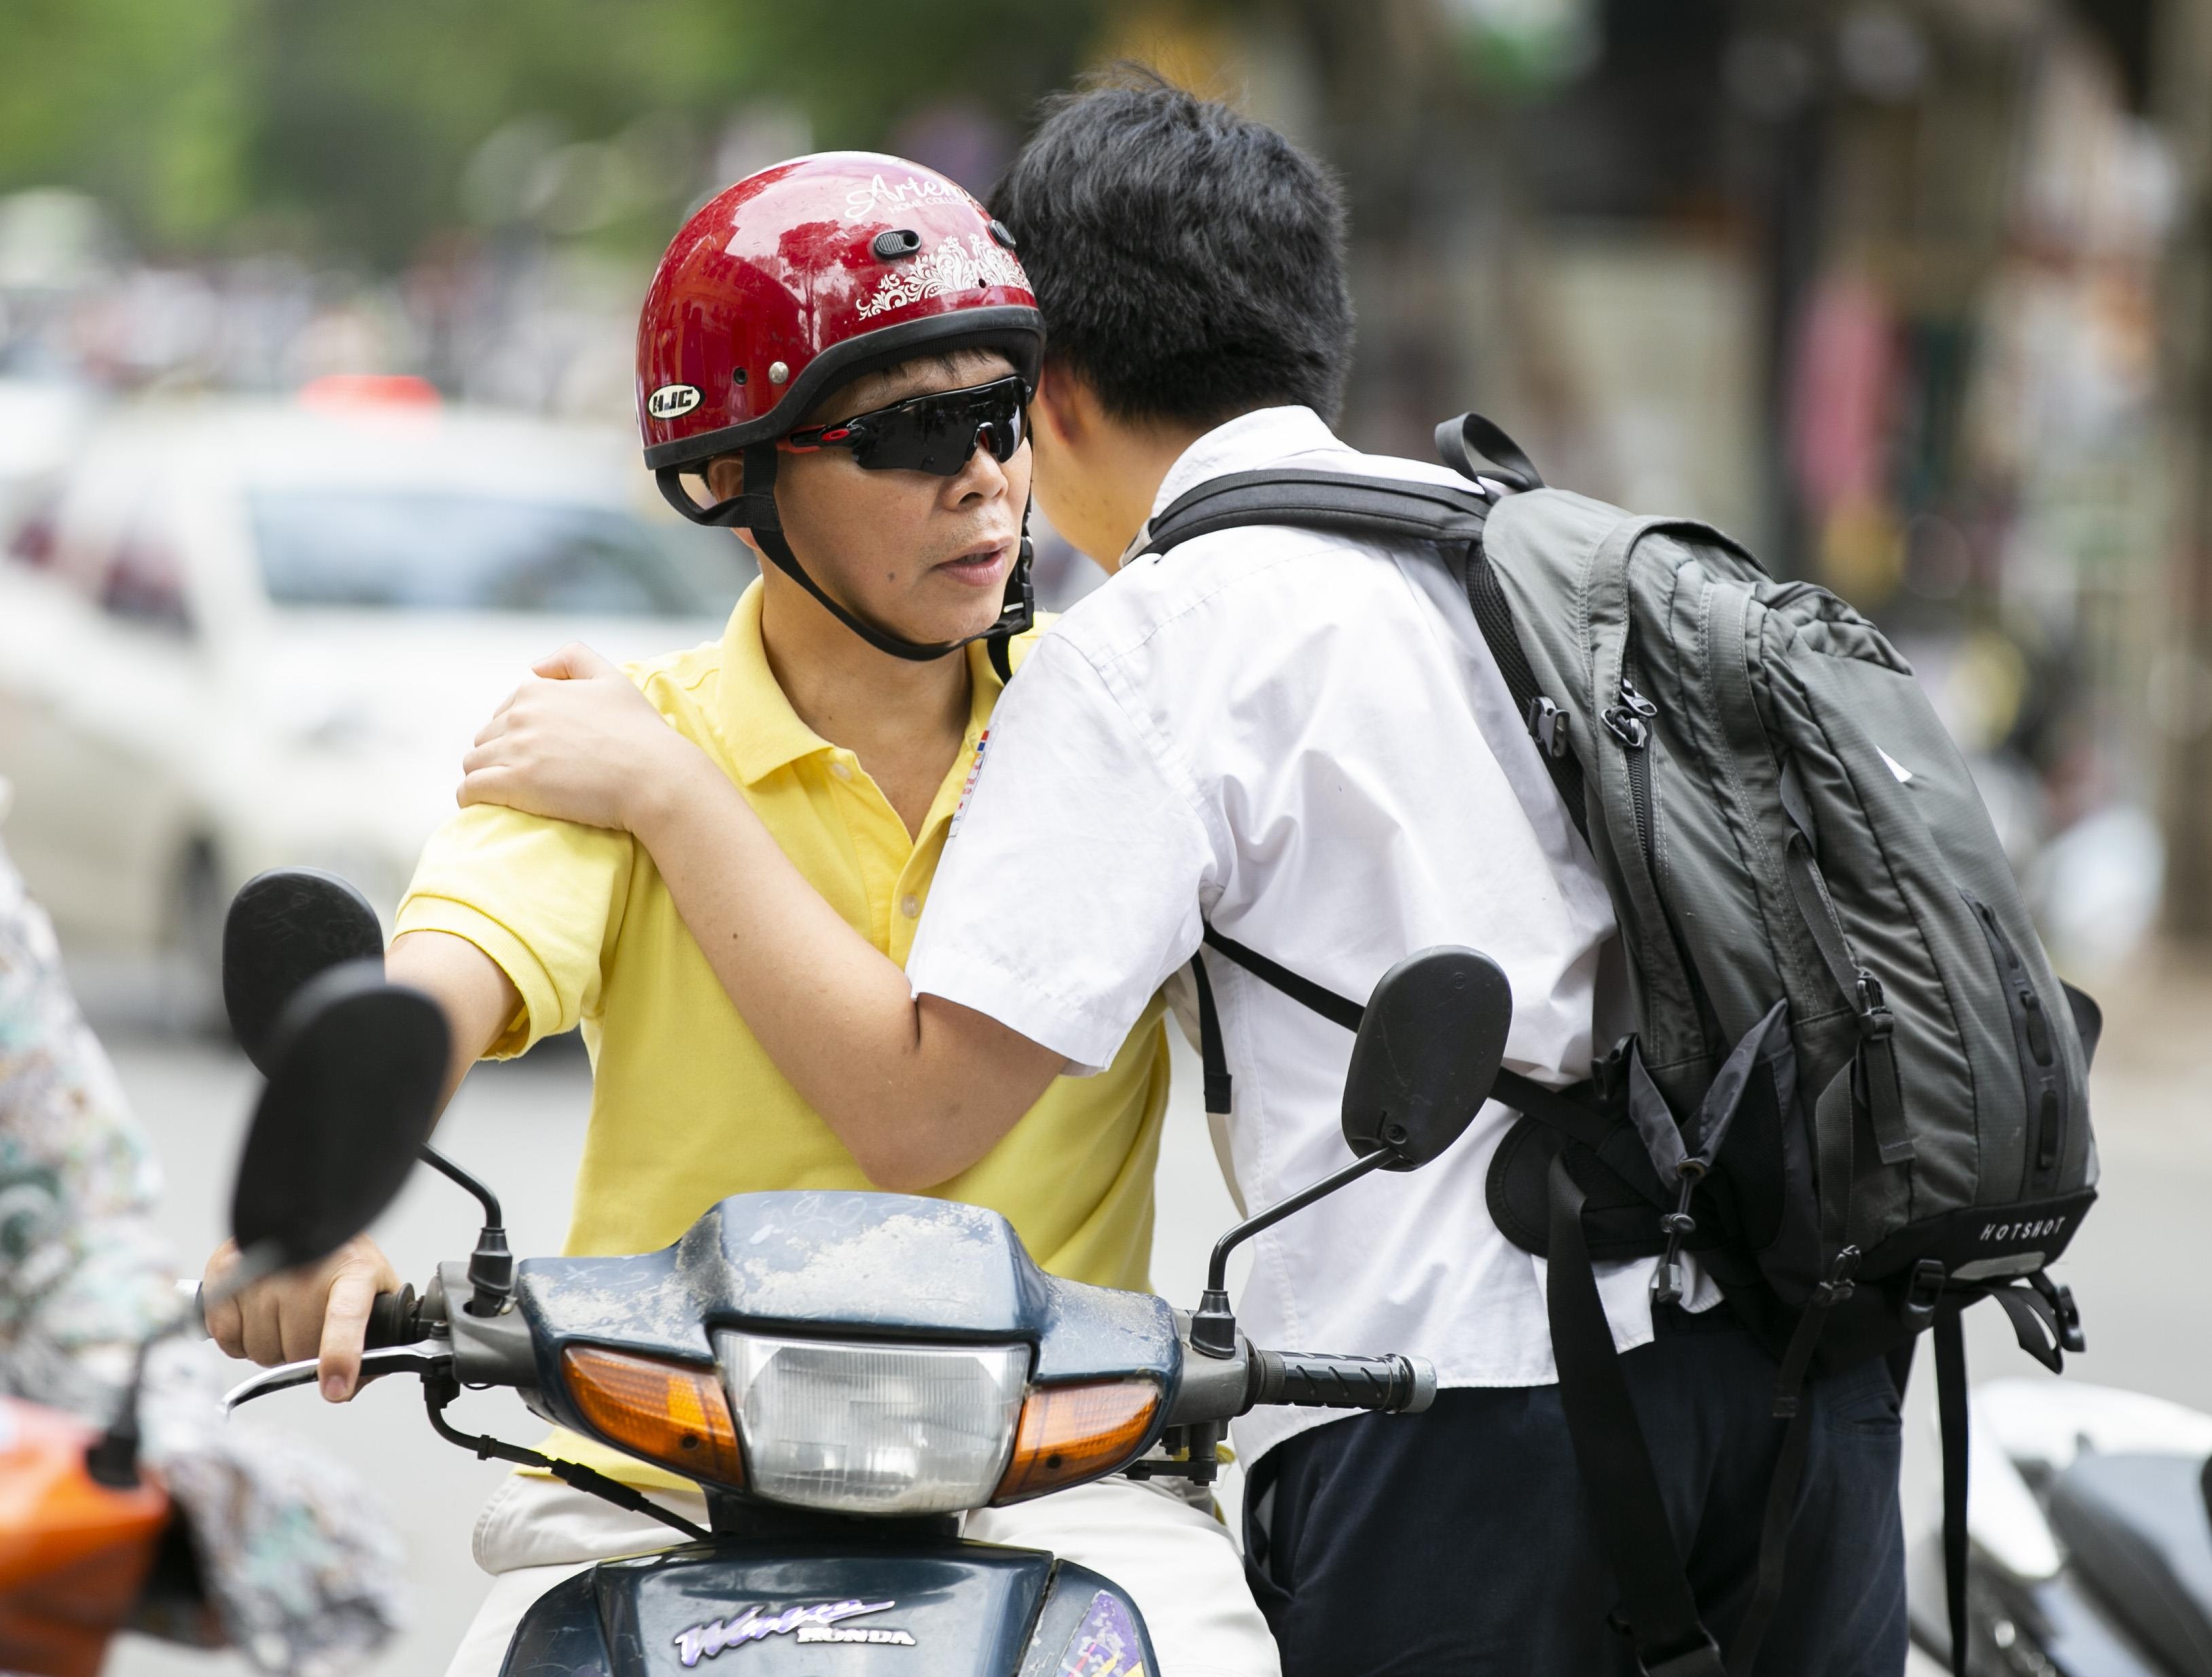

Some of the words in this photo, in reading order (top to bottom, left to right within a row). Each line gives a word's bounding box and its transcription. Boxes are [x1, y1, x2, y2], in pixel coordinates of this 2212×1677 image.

[888, 198, 925, 214] HOME
[652, 389, 693, 413] HJC
[1980, 1216, 2066, 1241] HOTSHOT
[798, 1627, 916, 1646] HONDA
